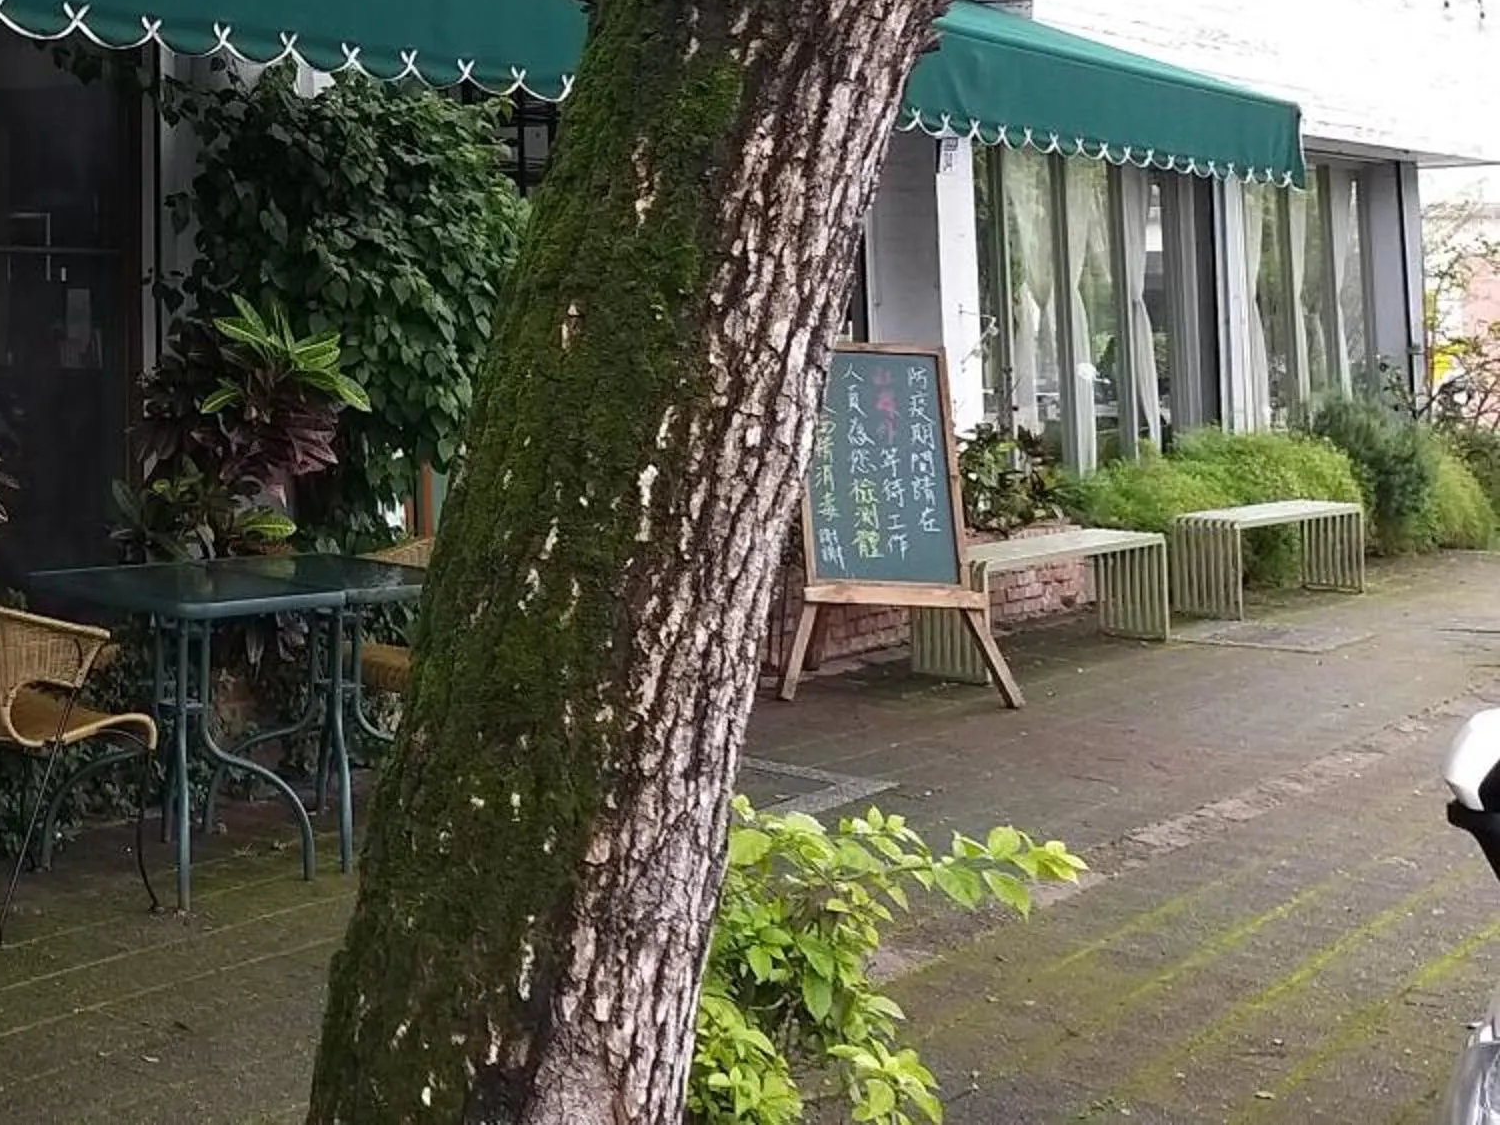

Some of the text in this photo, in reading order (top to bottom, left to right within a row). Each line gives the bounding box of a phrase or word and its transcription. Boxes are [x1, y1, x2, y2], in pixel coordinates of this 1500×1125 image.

[907, 366, 941, 533] 防疫期間請在
